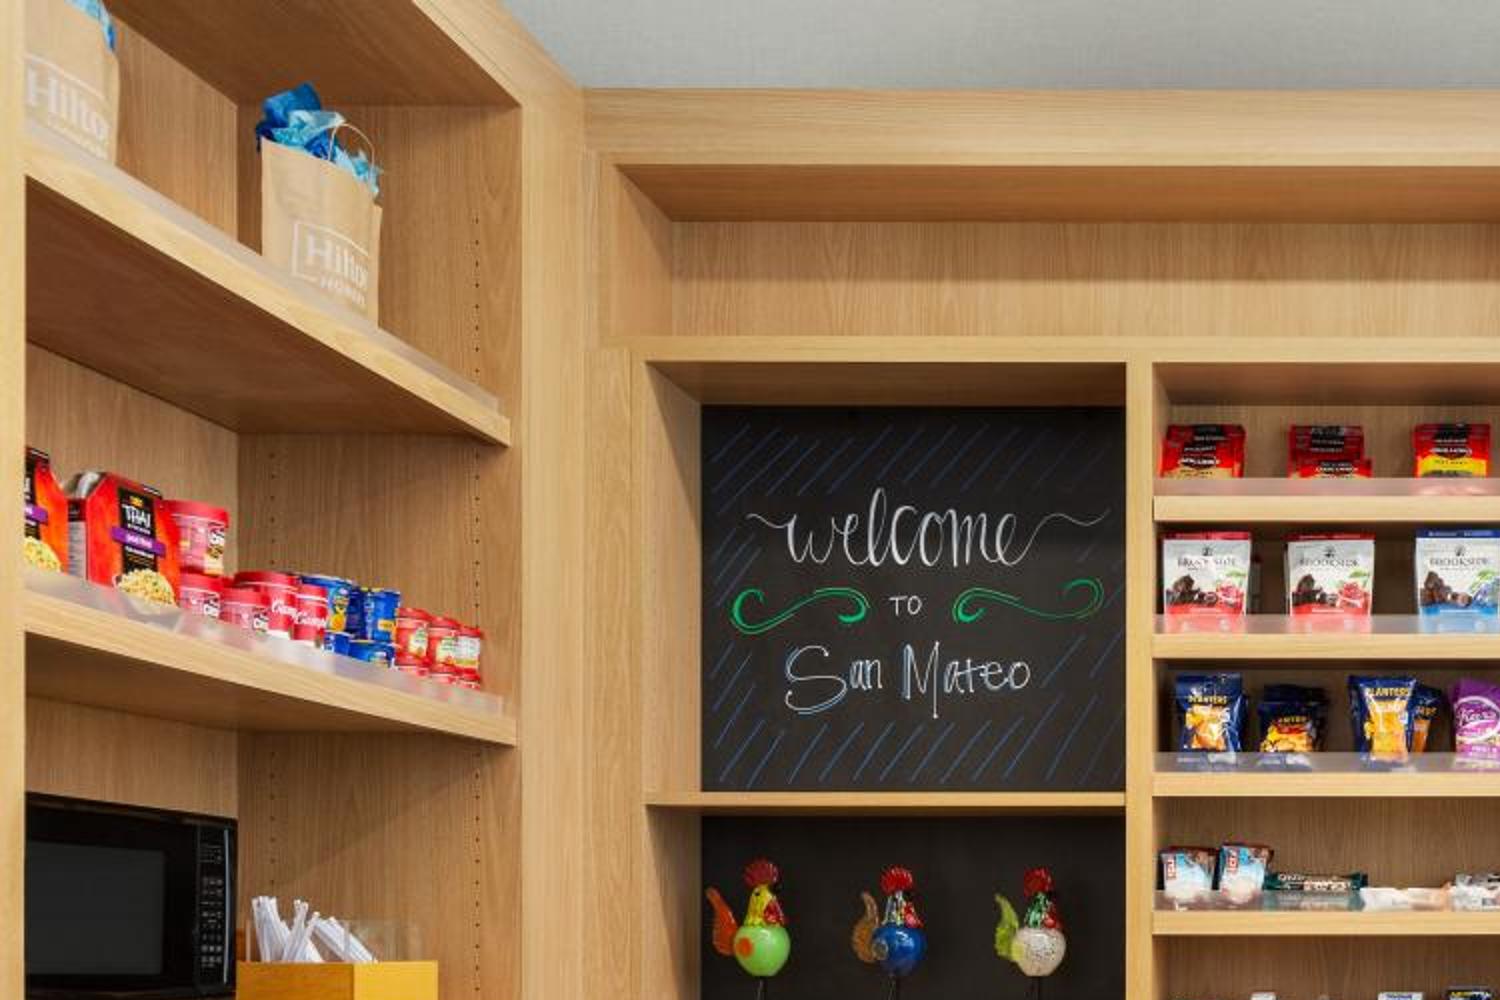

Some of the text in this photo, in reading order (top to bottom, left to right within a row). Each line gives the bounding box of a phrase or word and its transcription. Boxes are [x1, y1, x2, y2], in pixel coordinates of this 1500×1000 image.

[26, 68, 109, 141] Hilto
[305, 234, 368, 290] Hilto
[889, 596, 921, 616] TO
[784, 641, 1031, 719] San Mateo
